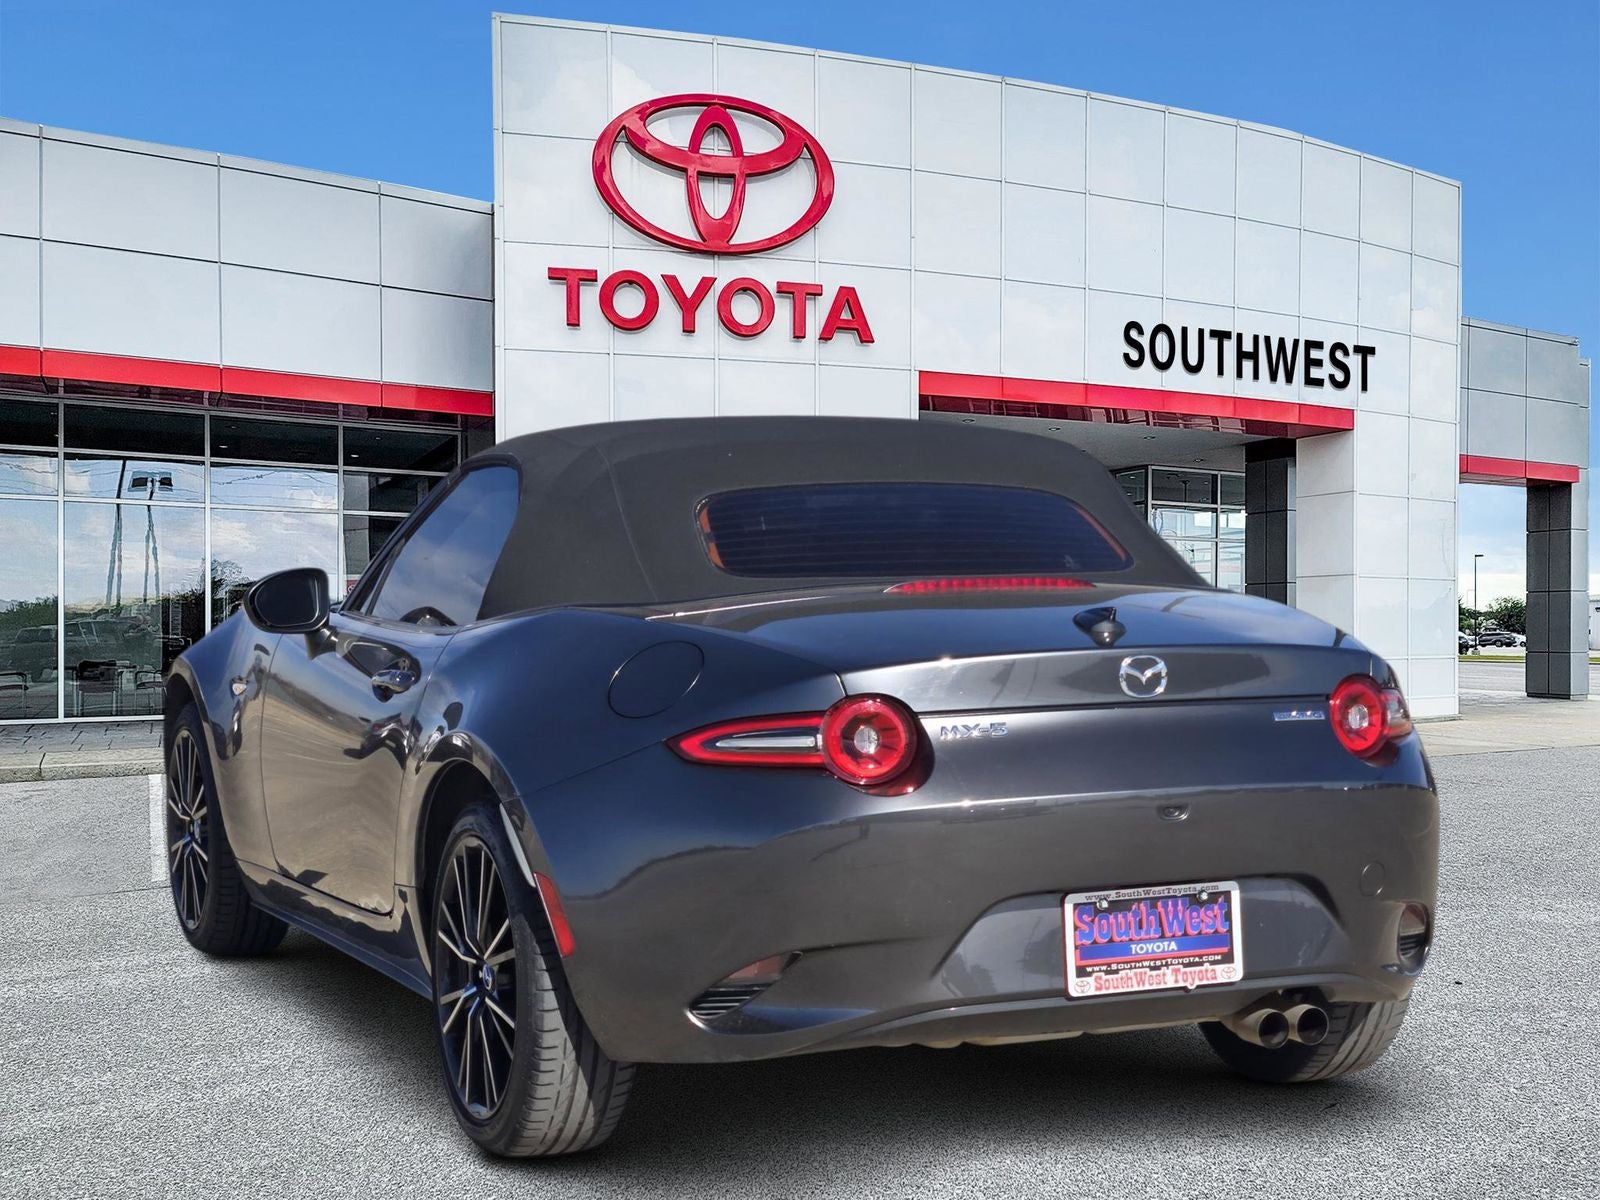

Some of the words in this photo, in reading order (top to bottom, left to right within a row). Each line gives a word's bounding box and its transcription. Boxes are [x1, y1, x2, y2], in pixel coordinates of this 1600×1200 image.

[548, 267, 875, 343] TOYOTA
[1123, 320, 1376, 392] SOUTHWEST
[940, 722, 1009, 739] MX-5
[1130, 941, 1178, 955] TOYOTA
[1094, 969, 1168, 992] SouthWest
[1171, 965, 1218, 988] Toyota
